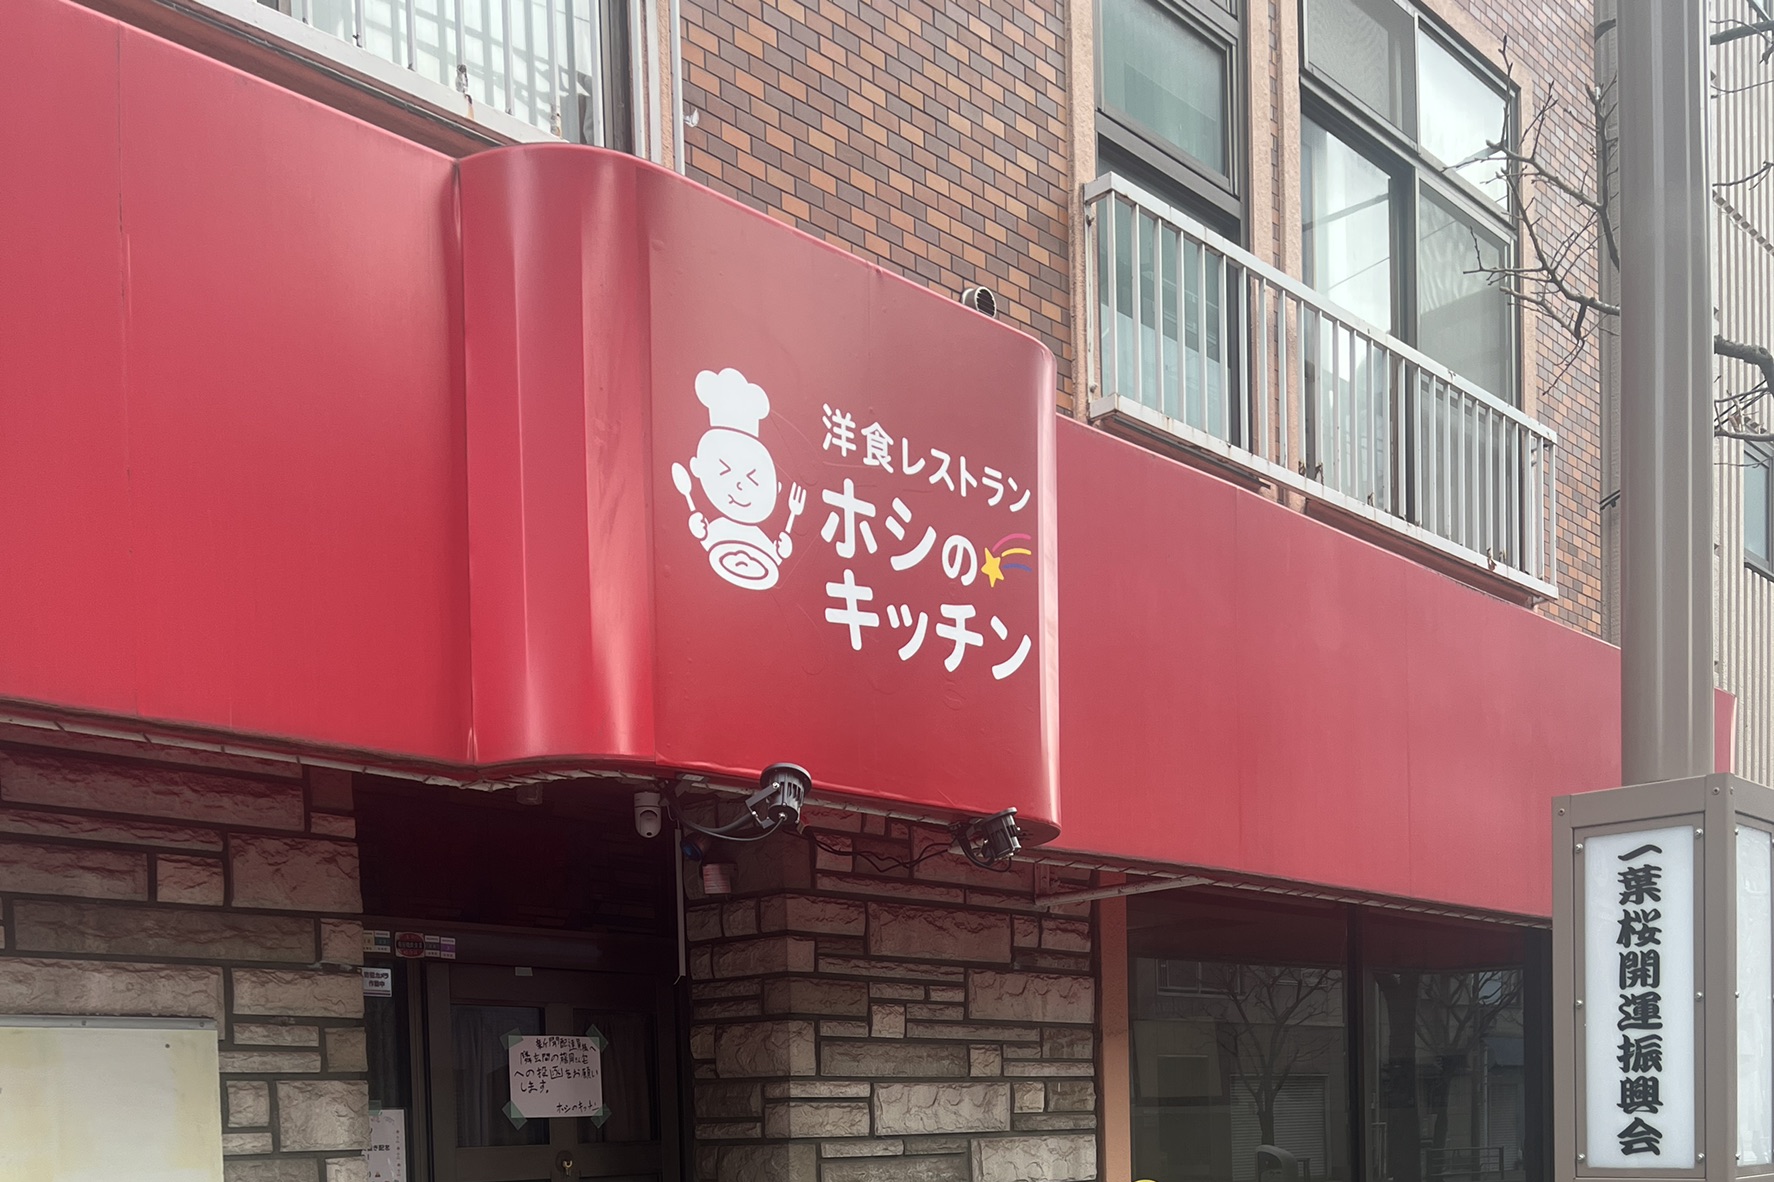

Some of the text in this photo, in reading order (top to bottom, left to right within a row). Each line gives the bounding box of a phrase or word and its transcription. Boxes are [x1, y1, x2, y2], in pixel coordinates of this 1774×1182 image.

[822, 402, 1031, 512] 洋食レストラン
[820, 477, 978, 586] ホシの
[824, 568, 1032, 680] キッチン
[1615, 843, 1663, 1156] 一葉桜開運振興会
